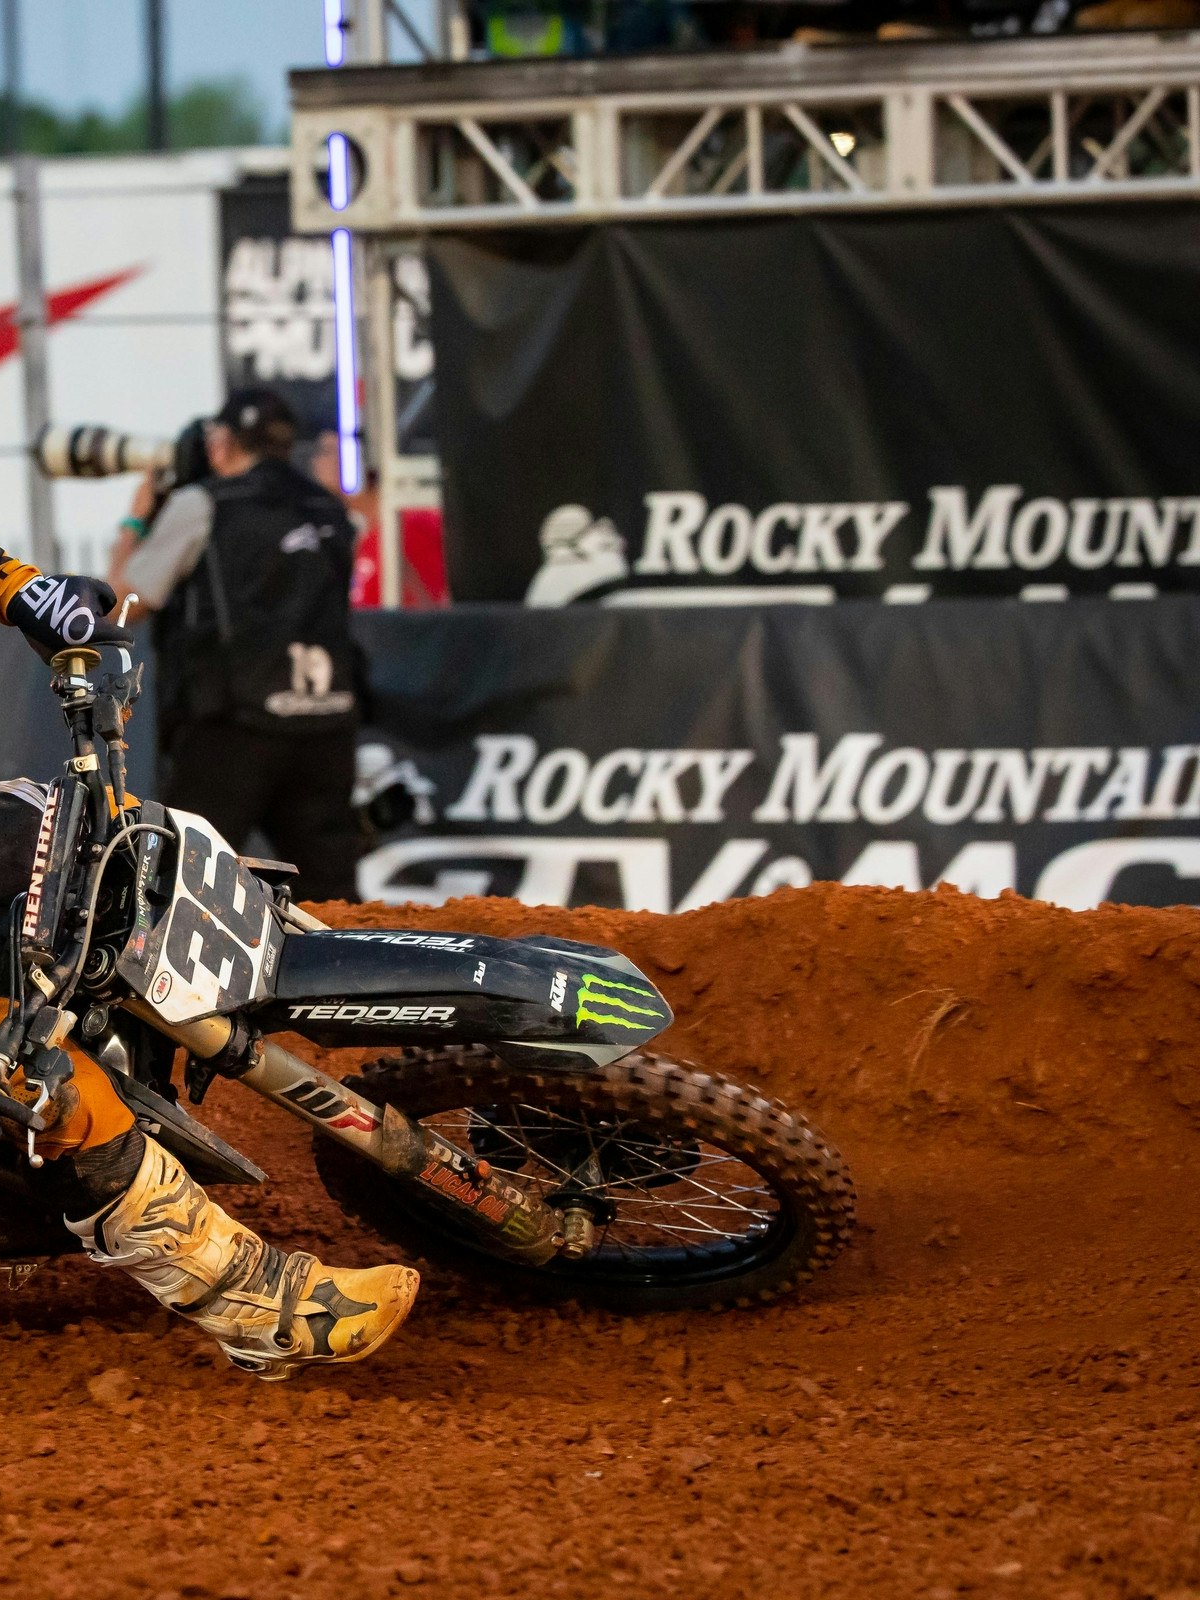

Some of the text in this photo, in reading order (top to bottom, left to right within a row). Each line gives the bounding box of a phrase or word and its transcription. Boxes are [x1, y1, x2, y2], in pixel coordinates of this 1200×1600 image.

[635, 490, 908, 576] ROCKY
[448, 733, 1200, 825] ROCKY MOUNTAI
[22, 787, 59, 938] RENTHAL
[137, 855, 151, 917] MONSTER
[166, 827, 266, 1010] 36
[288, 1005, 456, 1021] TEDDER
[549, 971, 568, 1013] KTM
[419, 1161, 482, 1205] LUCAS
[477, 1194, 510, 1223] OIL
